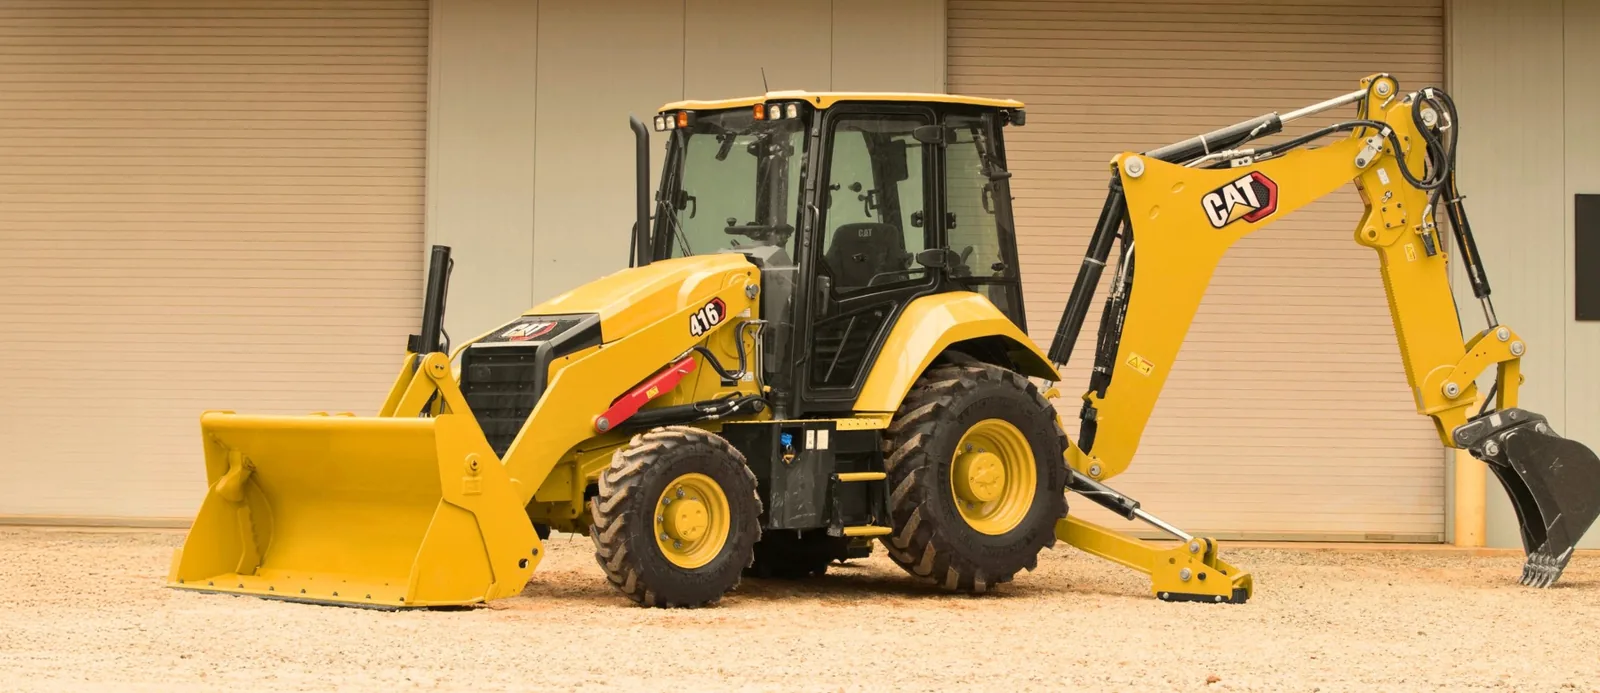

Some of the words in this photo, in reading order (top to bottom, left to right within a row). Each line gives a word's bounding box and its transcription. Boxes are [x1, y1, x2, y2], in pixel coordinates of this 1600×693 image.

[1203, 174, 1261, 228] CAT
[858, 228, 873, 237] CAT
[501, 323, 552, 337] CAT
[690, 302, 719, 336] 416
